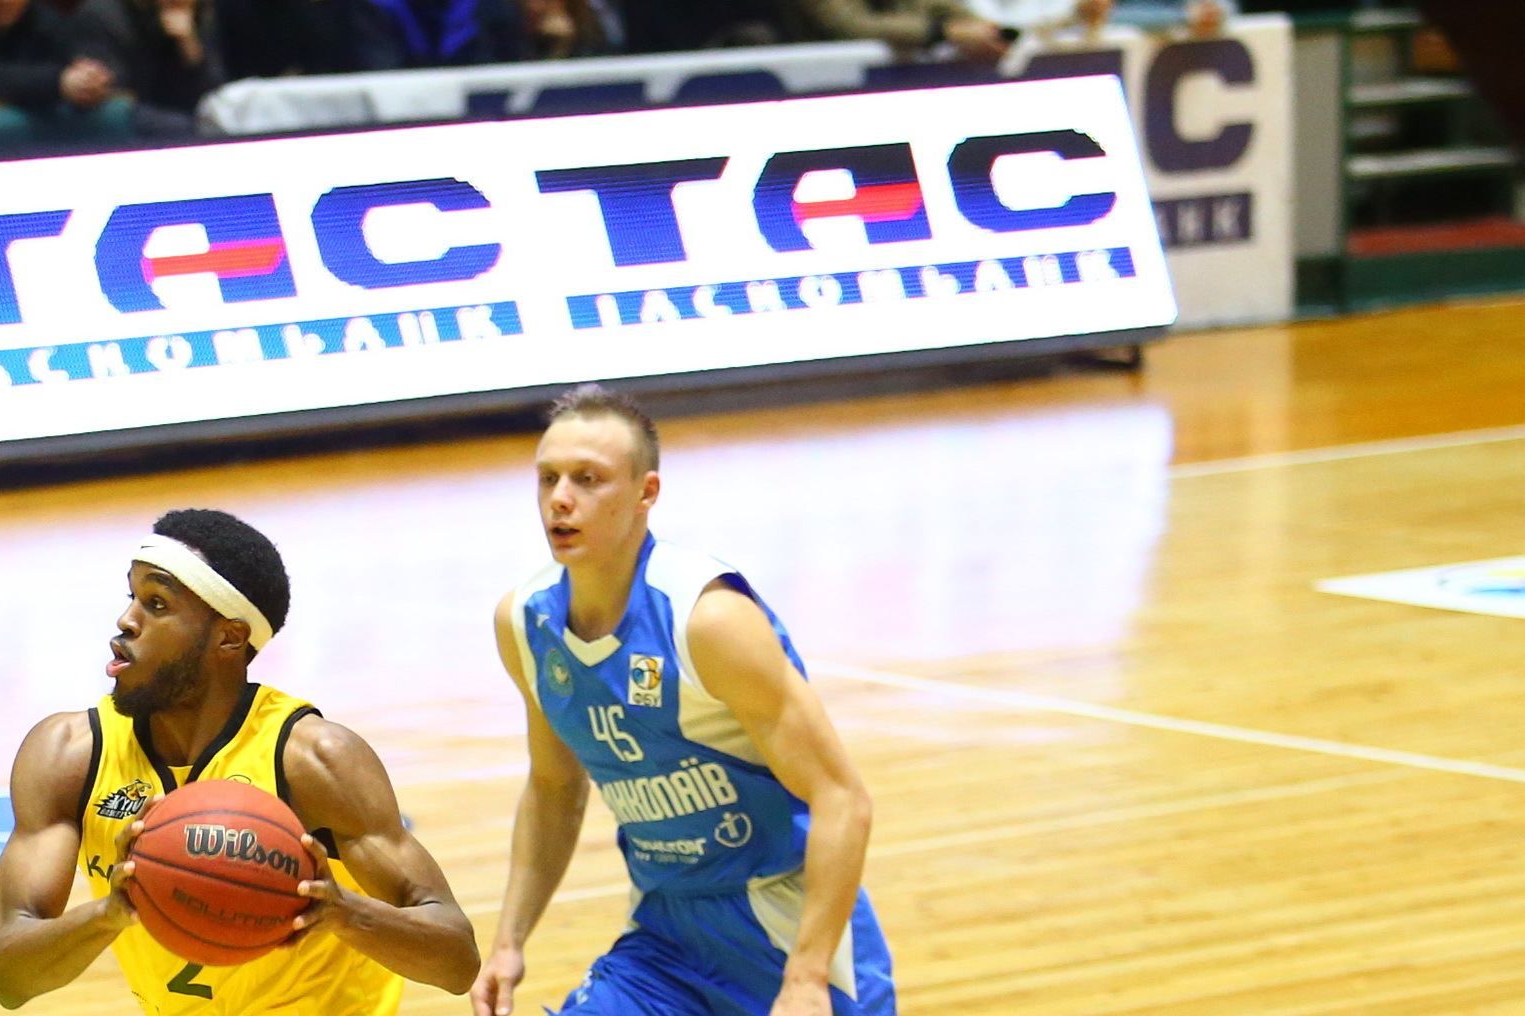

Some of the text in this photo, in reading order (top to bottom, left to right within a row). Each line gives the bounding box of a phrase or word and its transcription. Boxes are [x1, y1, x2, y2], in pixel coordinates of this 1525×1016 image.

[535, 128, 1116, 267] ТАС
[588, 703, 645, 762] 45
[183, 823, 300, 879] Wilson
